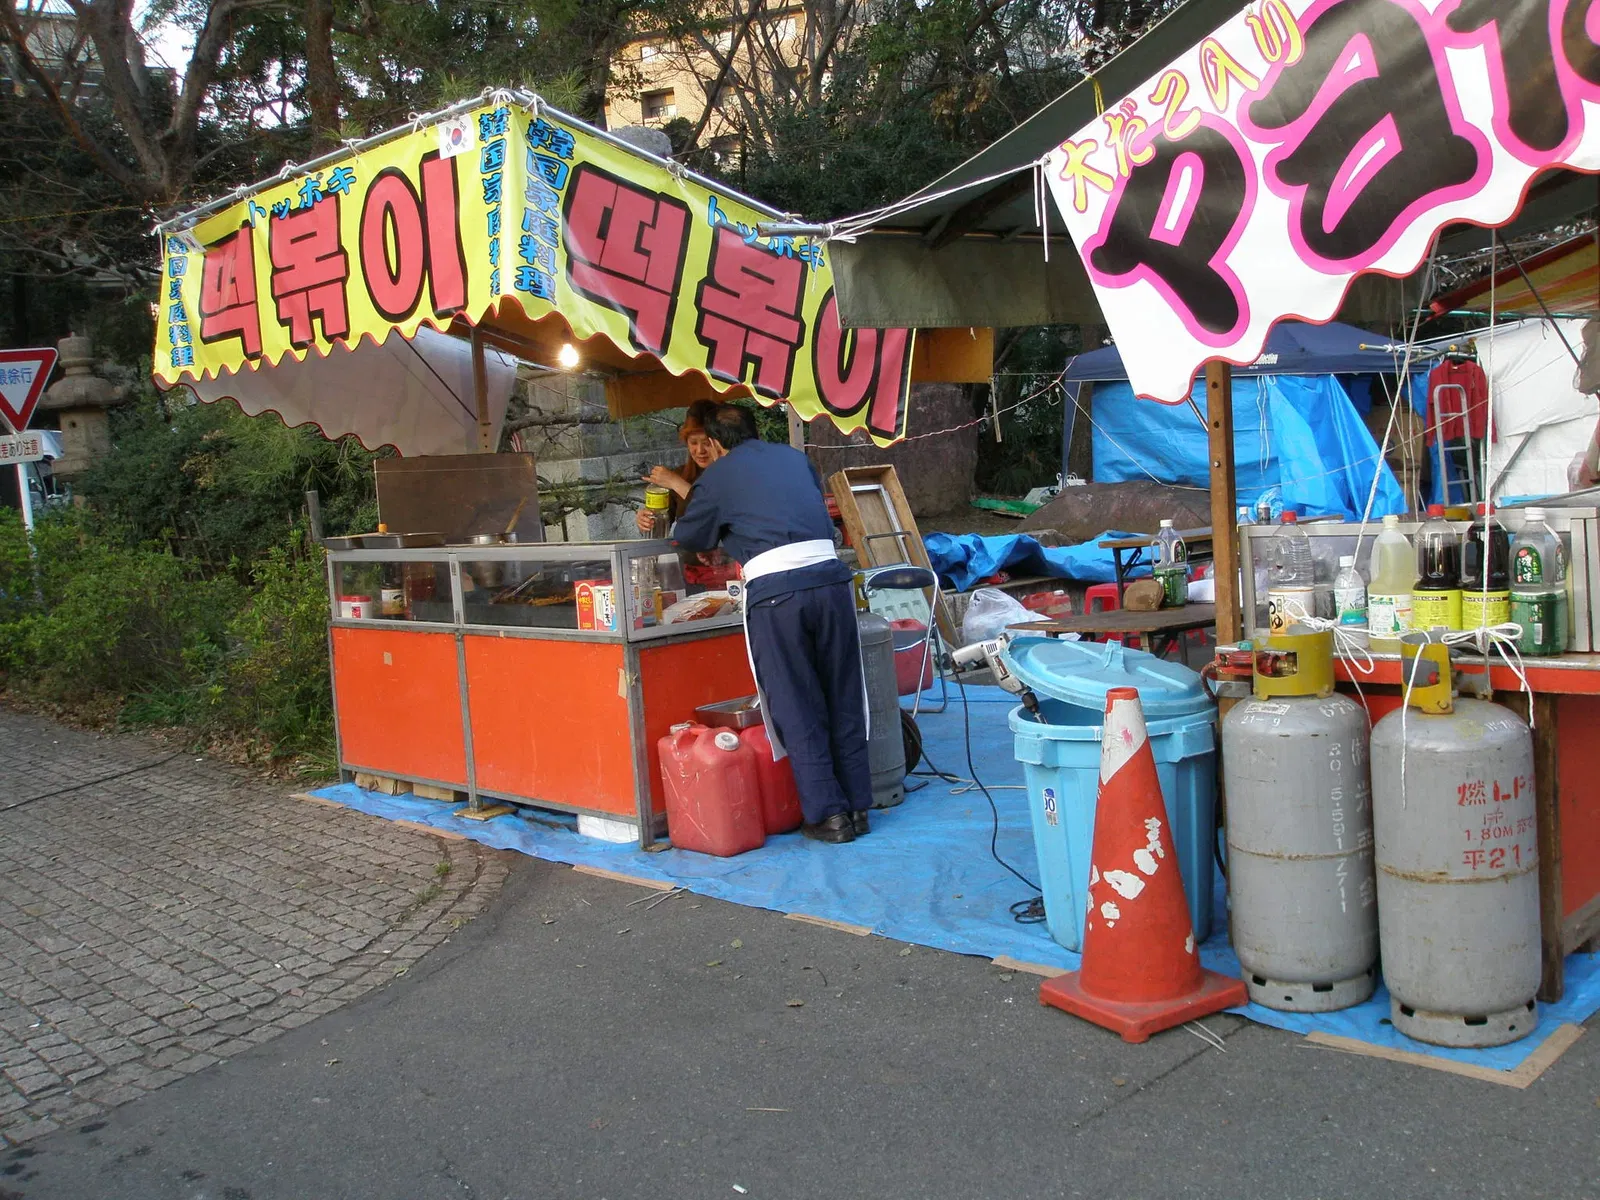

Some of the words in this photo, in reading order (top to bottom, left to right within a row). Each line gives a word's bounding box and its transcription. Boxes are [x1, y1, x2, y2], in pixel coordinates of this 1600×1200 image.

[246, 166, 358, 229] トッポキ
[514, 118, 577, 305] 韓国家庭料理
